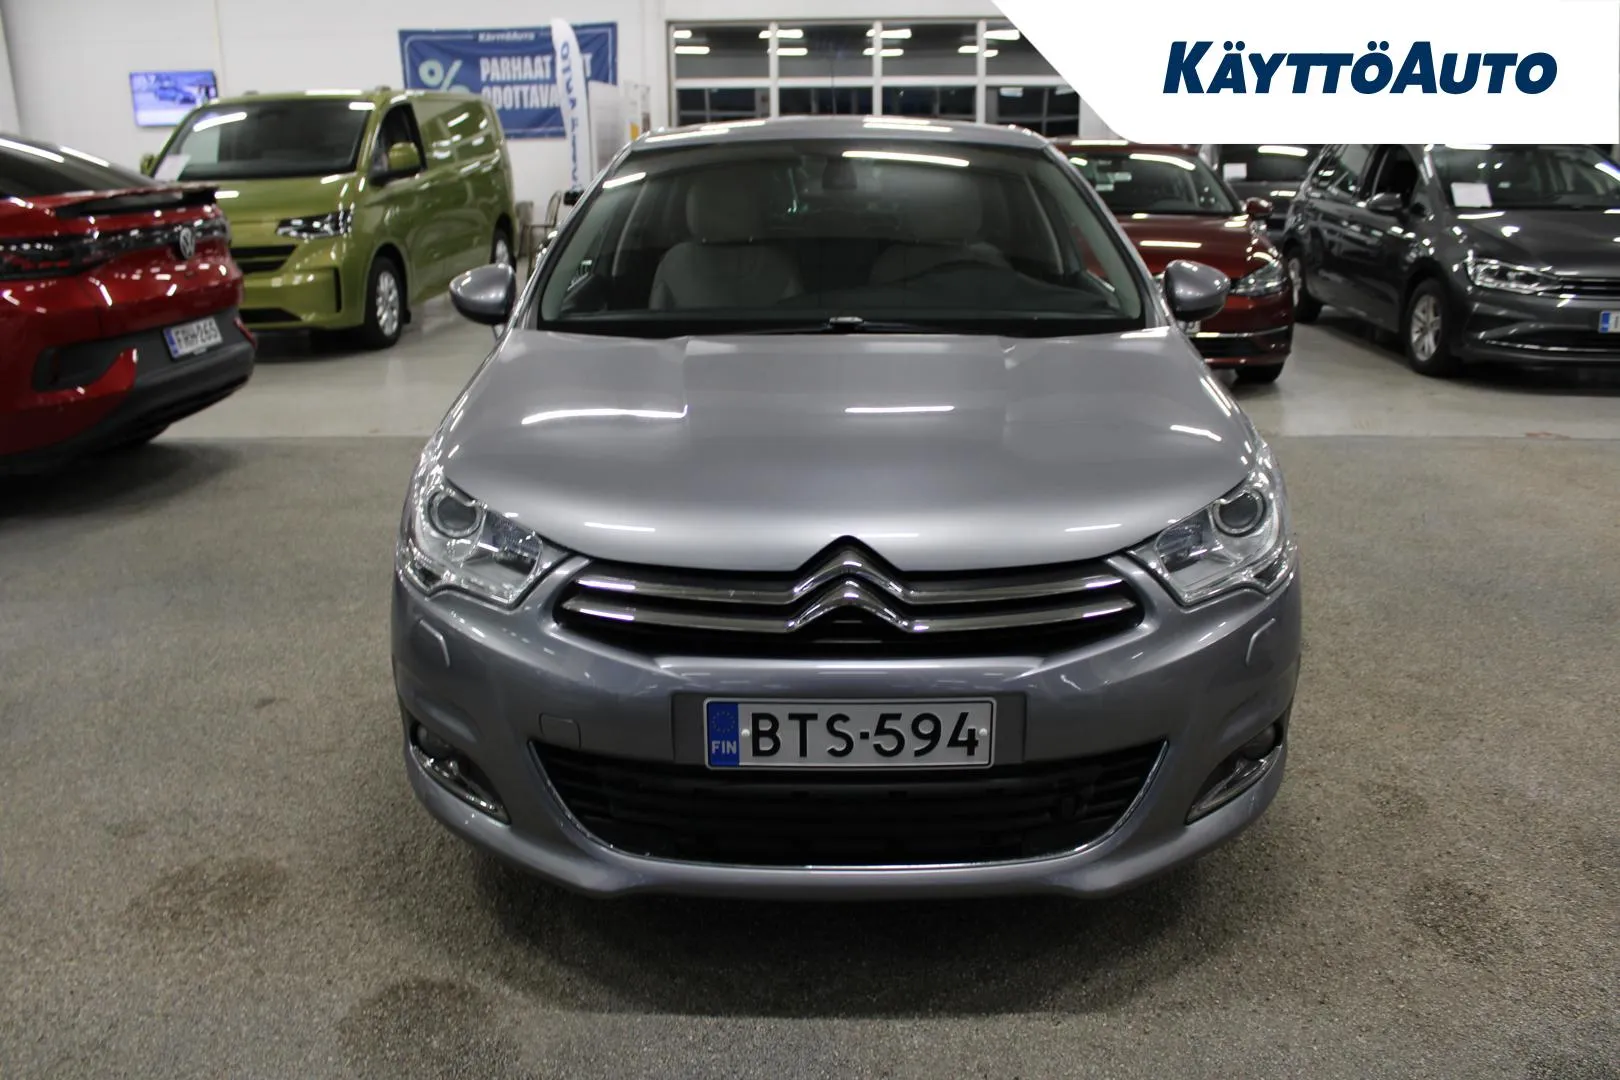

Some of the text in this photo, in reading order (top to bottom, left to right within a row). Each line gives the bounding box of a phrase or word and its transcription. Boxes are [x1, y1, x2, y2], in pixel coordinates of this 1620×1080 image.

[479, 54, 552, 82] PARHAAT
[711, 740, 737, 754] FIN
[751, 712, 979, 758] BTS-594
